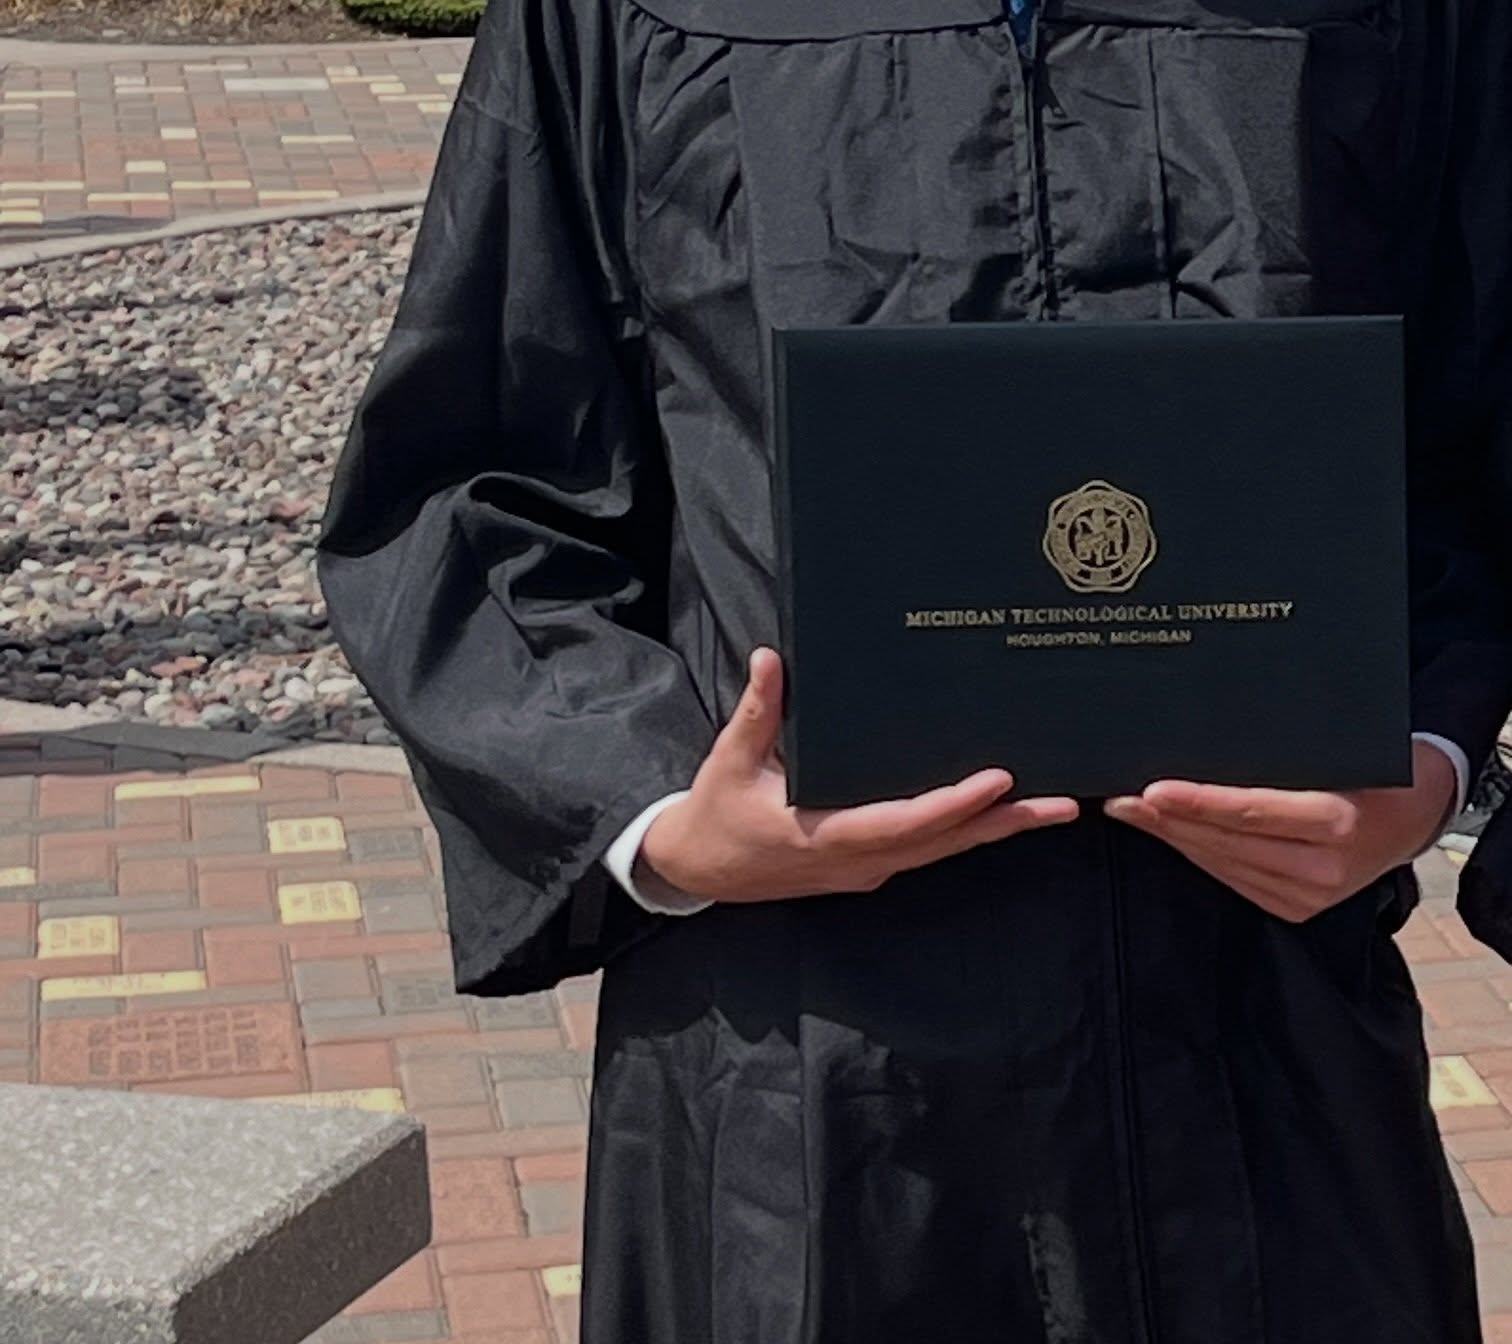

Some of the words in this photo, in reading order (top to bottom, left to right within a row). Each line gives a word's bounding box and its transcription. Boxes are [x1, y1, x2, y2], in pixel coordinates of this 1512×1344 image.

[905, 609, 1006, 627] MICHIGAN
[1011, 605, 1172, 625] TECHNOLOGICAL
[1178, 601, 1293, 620] UNIVERSITY
[1006, 631, 1106, 647] HOUGHTON,
[1110, 629, 1192, 644] MICHIGAN
